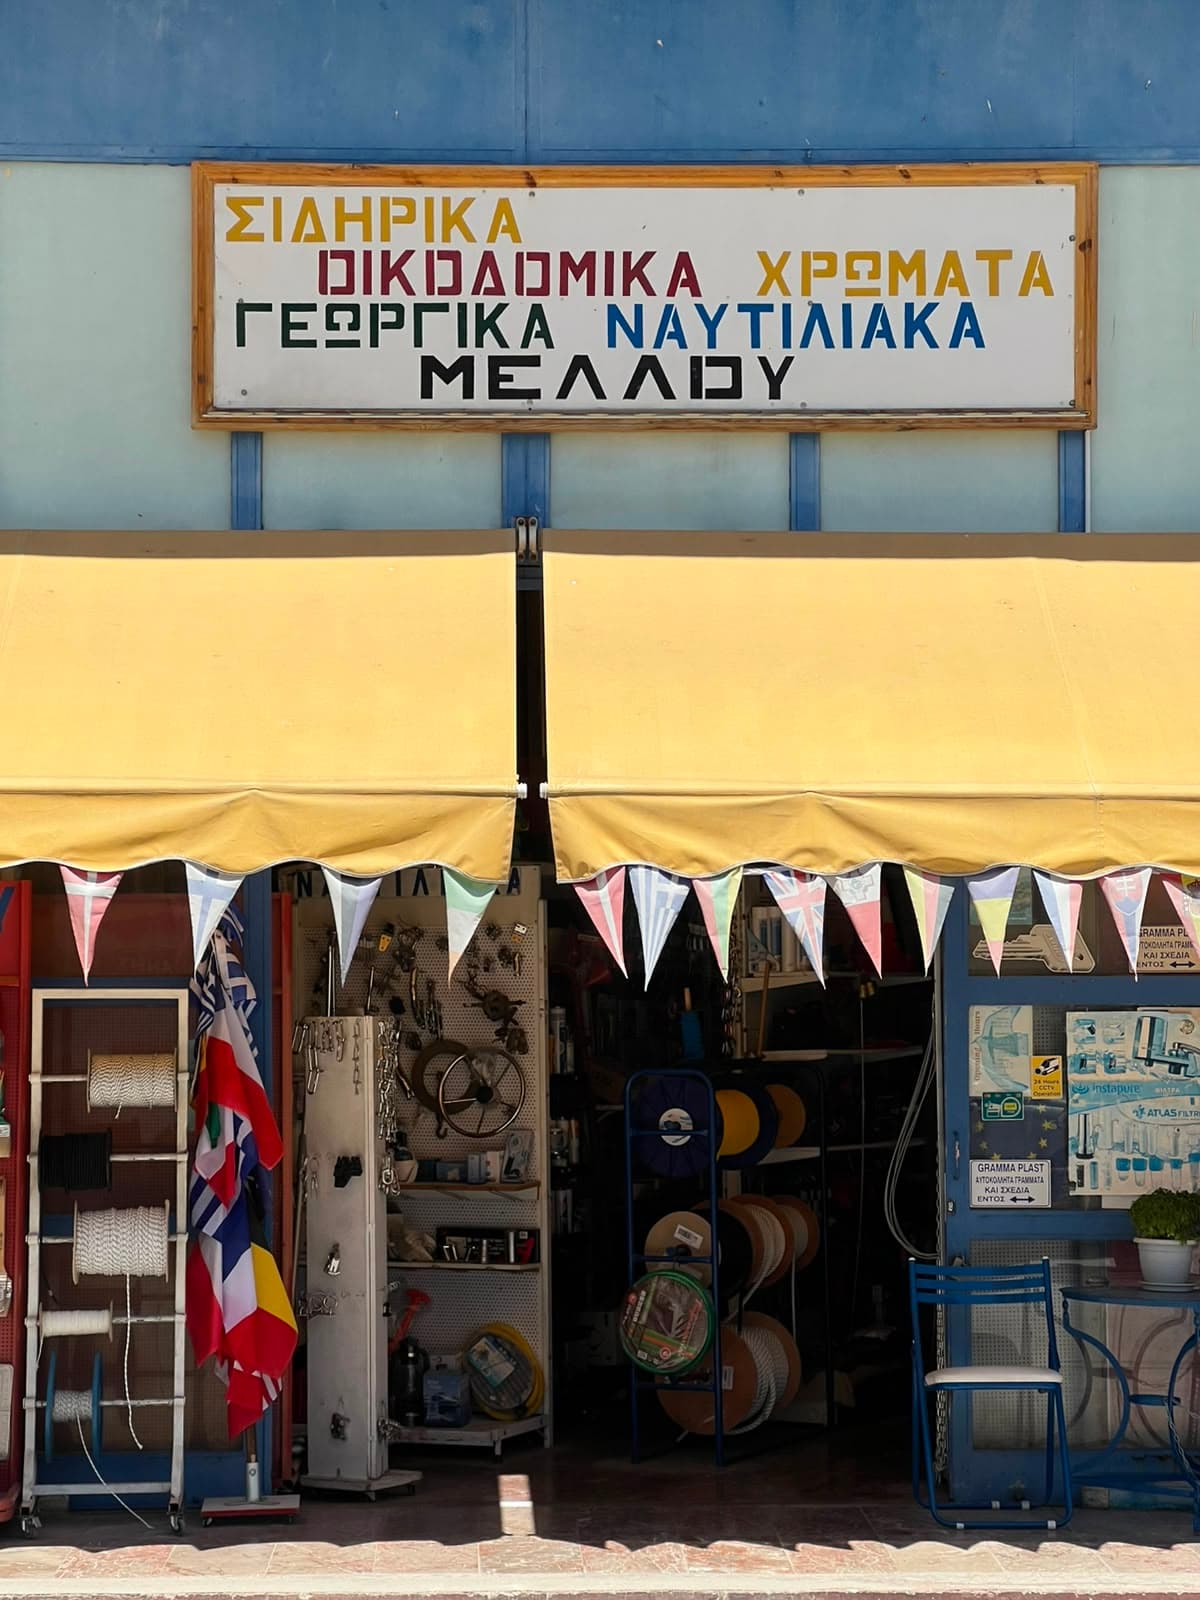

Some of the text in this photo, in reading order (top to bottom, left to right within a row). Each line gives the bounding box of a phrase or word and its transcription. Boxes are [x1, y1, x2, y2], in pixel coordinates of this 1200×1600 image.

[226, 196, 522, 243] ΣΙΔΗΡΙΚΑ
[318, 249, 1054, 297] ΟΙΚΟΔΟΜΙΚΑ ΧΡΩΜΑΤΑ
[236, 302, 986, 349] ΓΕΩΡΓΙΚΑ ΝΑΥΤΙΛΙΑΚΑ
[421, 355, 795, 400] ΜΕΛΛΟΥ
[1093, 1083, 1141, 1096] instapure
[1147, 1109, 1177, 1117] ATLAS
[977, 1163, 1045, 1173] GRAMMA PLAST
[1015, 1176, 1044, 1184] ΓΡΑΜΜΑΤΑ
